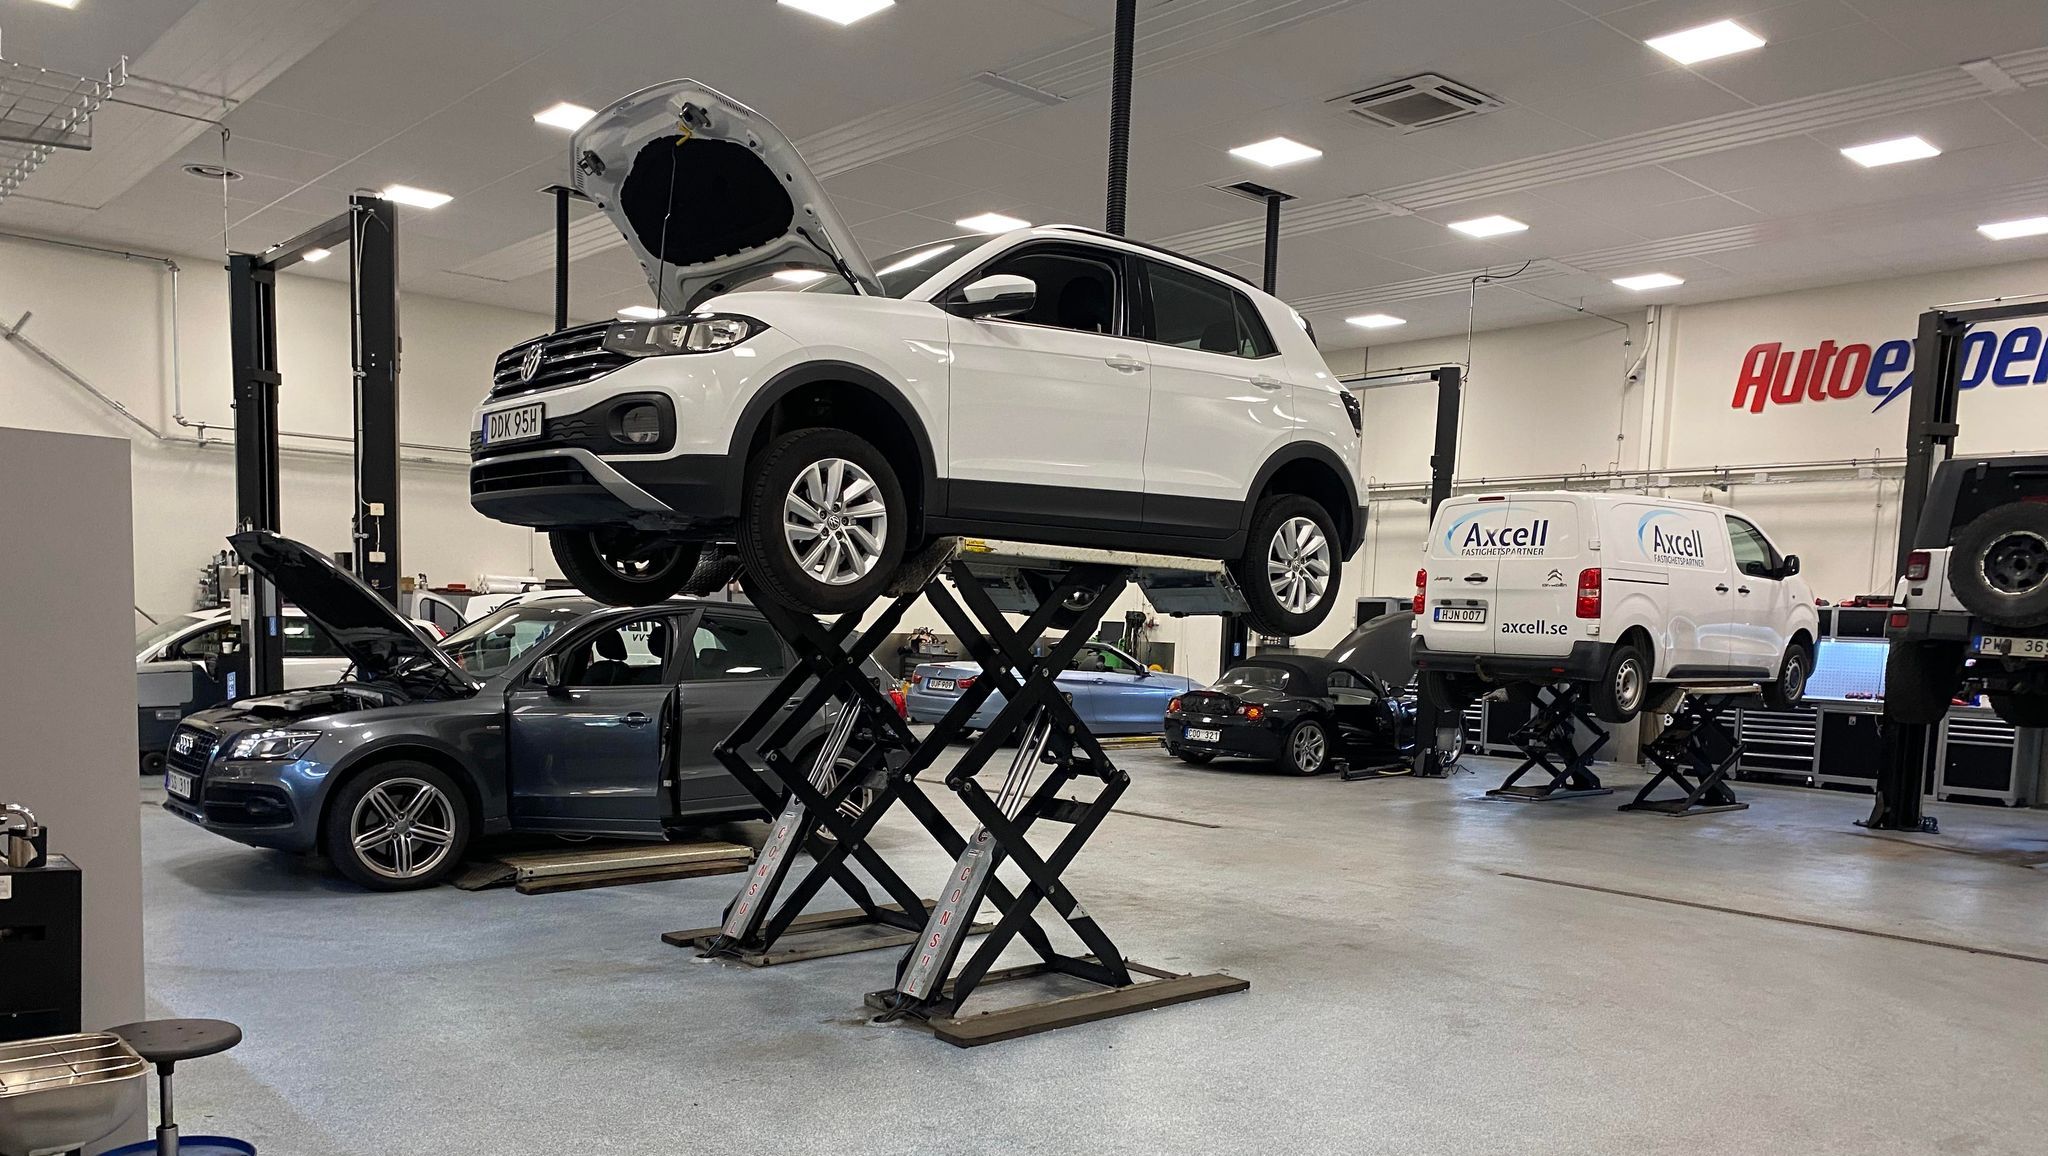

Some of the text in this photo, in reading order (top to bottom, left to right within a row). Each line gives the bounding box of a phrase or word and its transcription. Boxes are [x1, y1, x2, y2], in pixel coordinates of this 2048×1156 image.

[491, 407, 538, 439] DDK 95H
[1463, 519, 1549, 548] Axcell
[1653, 525, 1704, 558] Axcell
[1461, 547, 1545, 556] FASTIGHETSPARTNER
[1654, 554, 1705, 567] FASTIGHETSPARTNER
[1442, 610, 1481, 621] HJN 007
[1501, 620, 1568, 635] axcell.se
[2024, 639, 2048, 653] 36
[1204, 730, 1218, 740] 321
[730, 827, 786, 934] CONSUL
[909, 867, 971, 993] CONSUL
